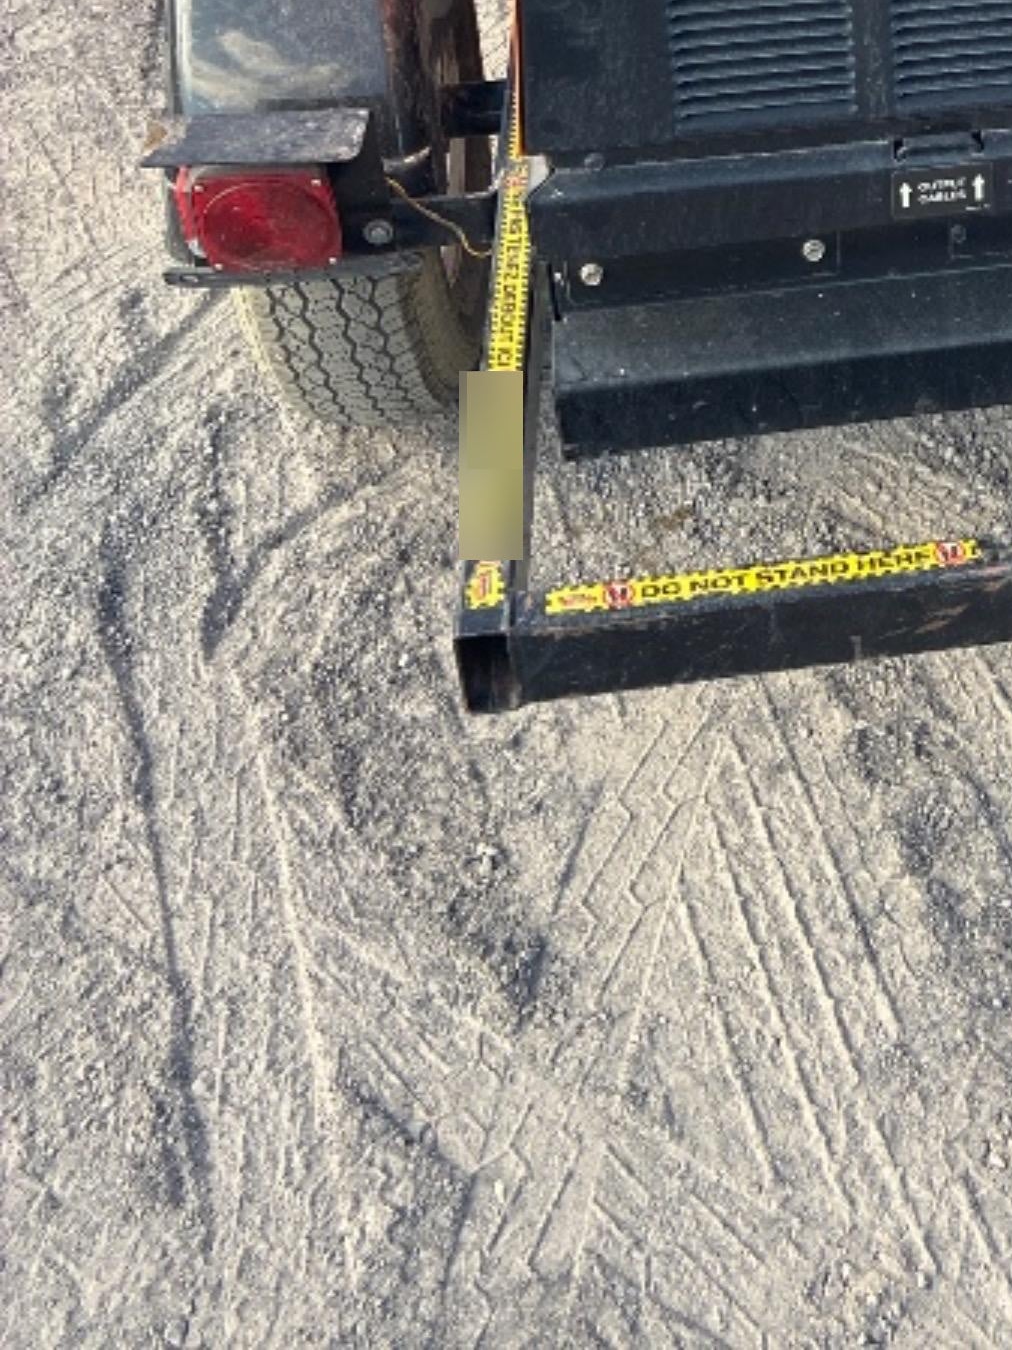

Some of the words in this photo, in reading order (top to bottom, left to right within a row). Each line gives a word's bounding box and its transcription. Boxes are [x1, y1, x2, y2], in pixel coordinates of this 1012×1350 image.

[640, 580, 682, 600] DO
[688, 572, 746, 594] NOT
[754, 559, 850, 586] STAND
[855, 549, 931, 574] HERE
